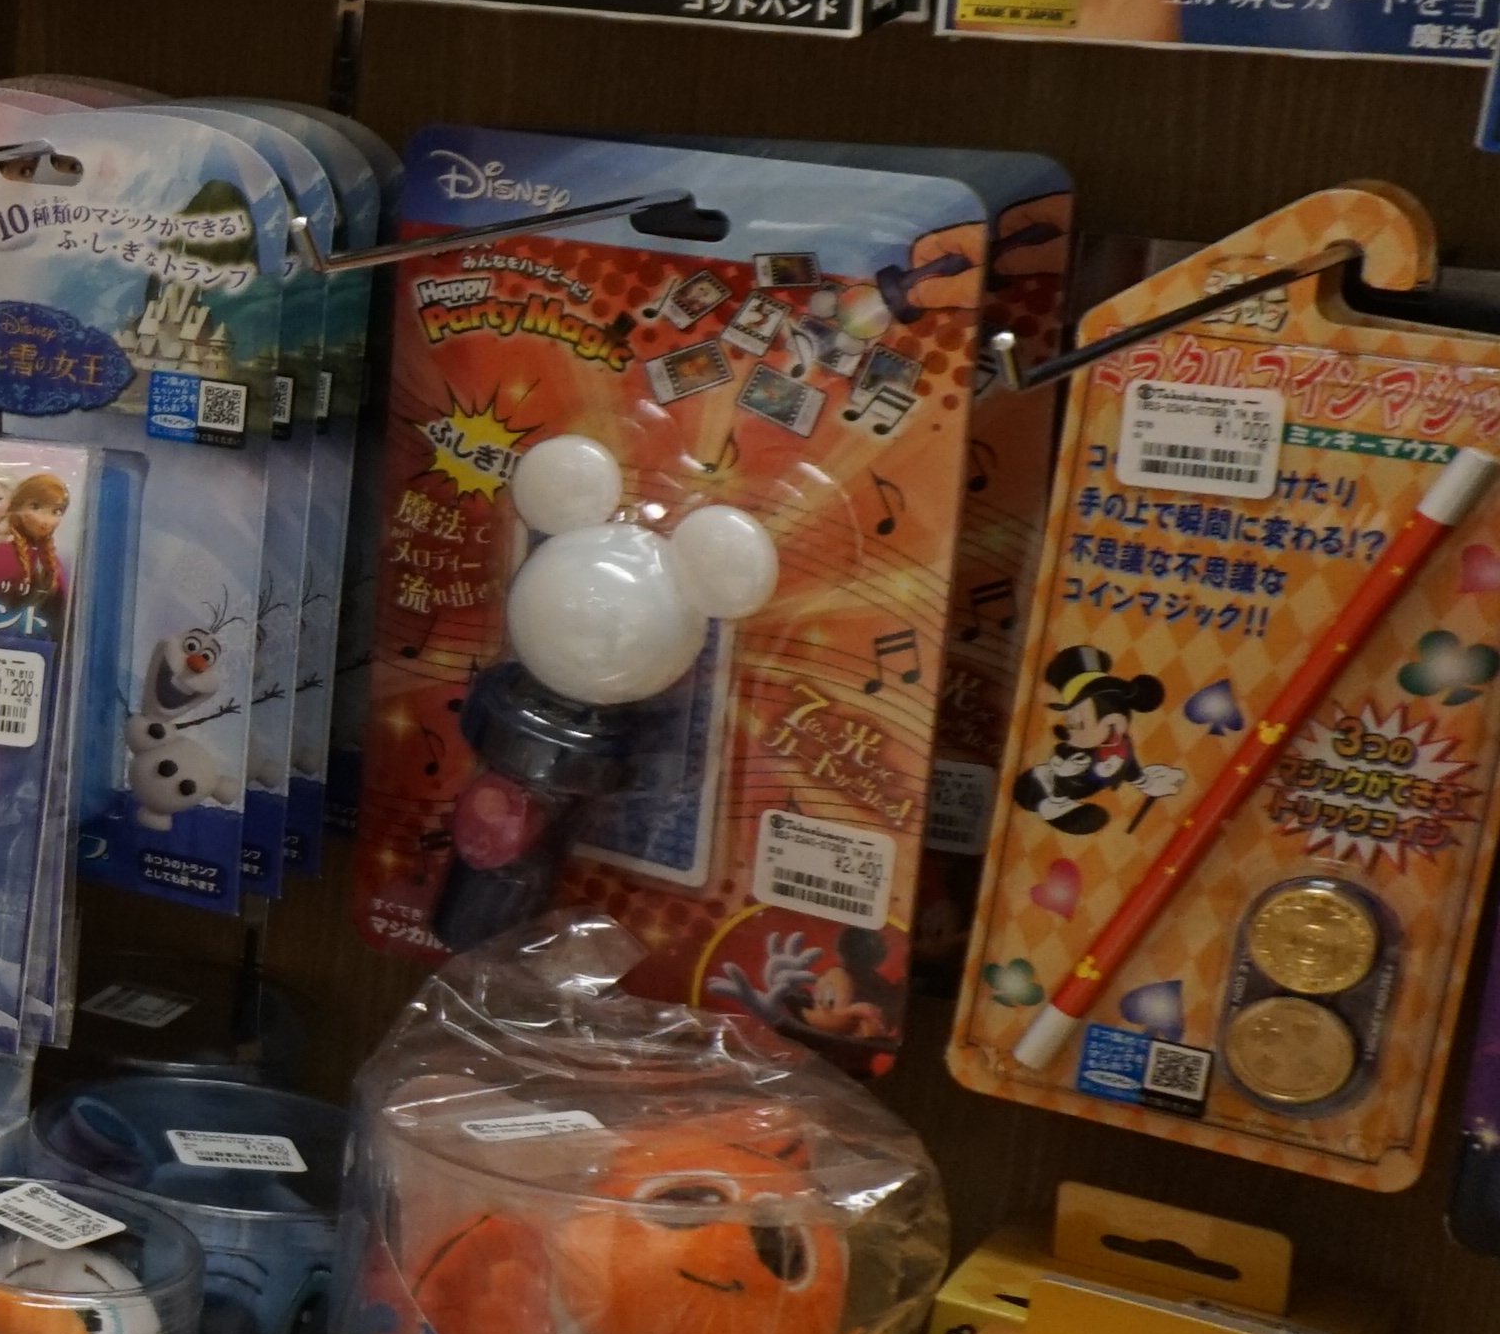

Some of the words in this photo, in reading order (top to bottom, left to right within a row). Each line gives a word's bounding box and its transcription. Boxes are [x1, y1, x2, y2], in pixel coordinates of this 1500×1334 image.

[418, 278, 491, 304] Happy
[418, 297, 524, 343] Party
[521, 294, 634, 372] Magic
[1287, 426, 1451, 462] ミッキーマウス
[1069, 533, 1288, 596] 不思議な不思議な
[1332, 717, 1416, 767] 3つの
